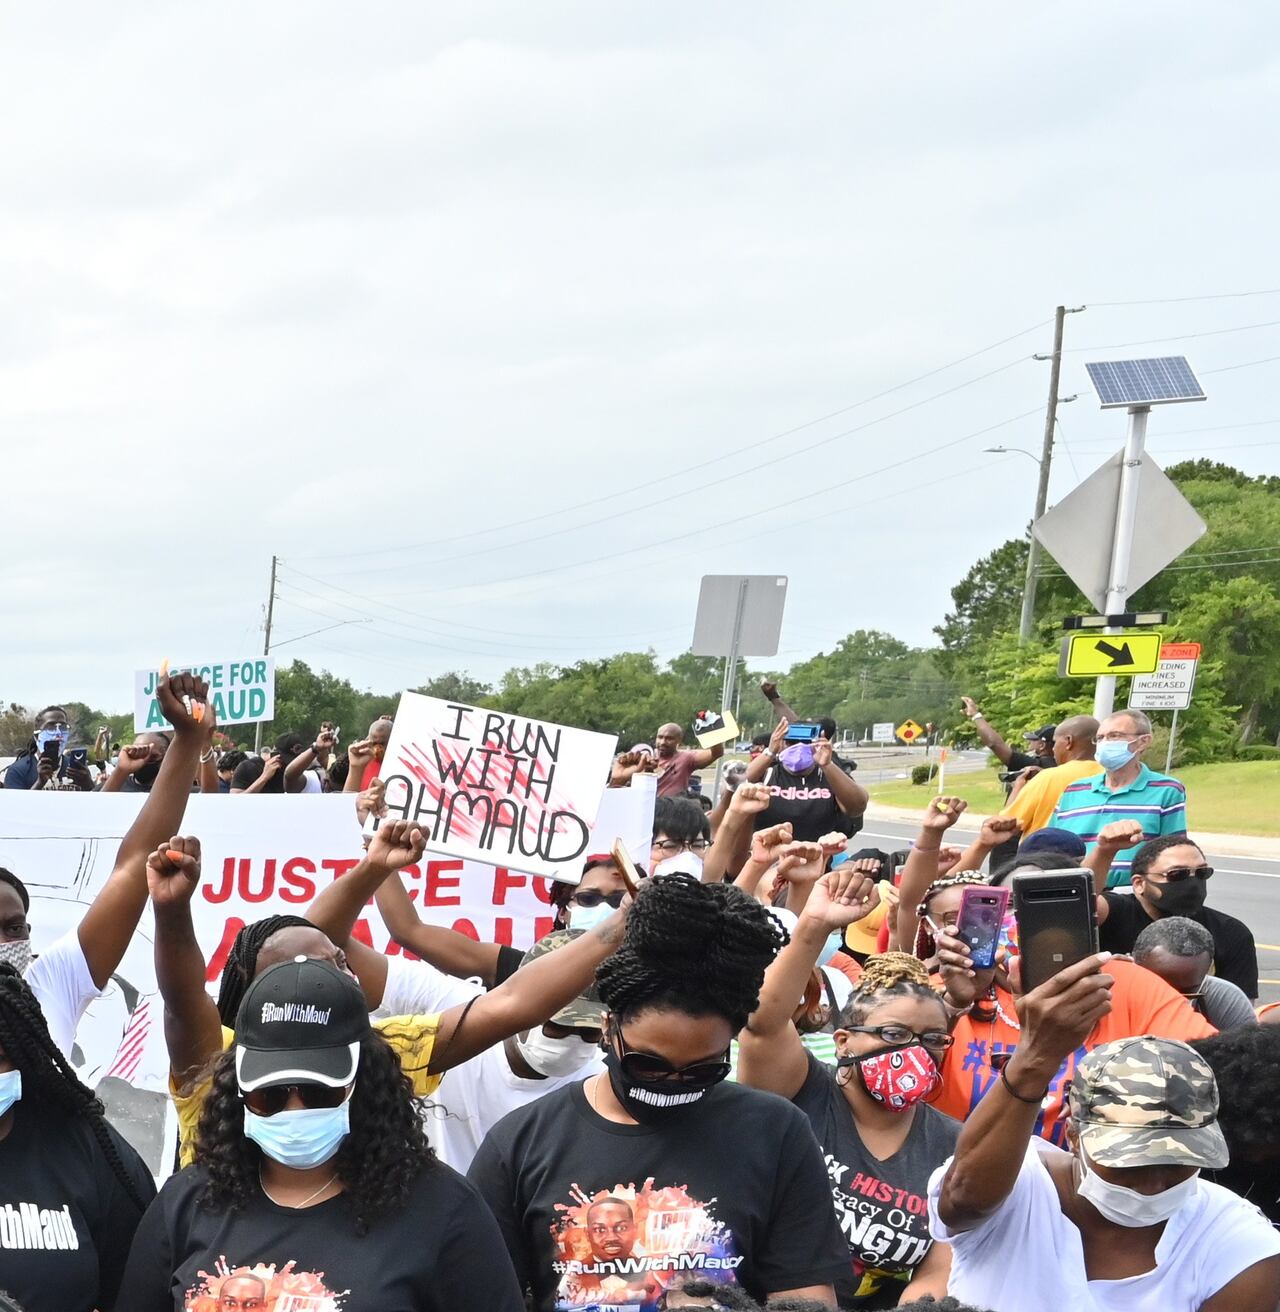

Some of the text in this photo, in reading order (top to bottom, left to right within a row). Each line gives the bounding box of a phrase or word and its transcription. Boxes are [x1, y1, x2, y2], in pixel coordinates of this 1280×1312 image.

[230, 661, 266, 686] FOR
[146, 688, 266, 728] AAUD
[441, 704, 561, 762] I RUN
[432, 739, 555, 803] WITH
[769, 785, 832, 800] adidas
[373, 774, 589, 862] AHMAUD
[202, 857, 464, 906] JUSTCE
[887, 1209, 915, 1231] Of
[552, 1253, 745, 1275] #iRunWithMaud
